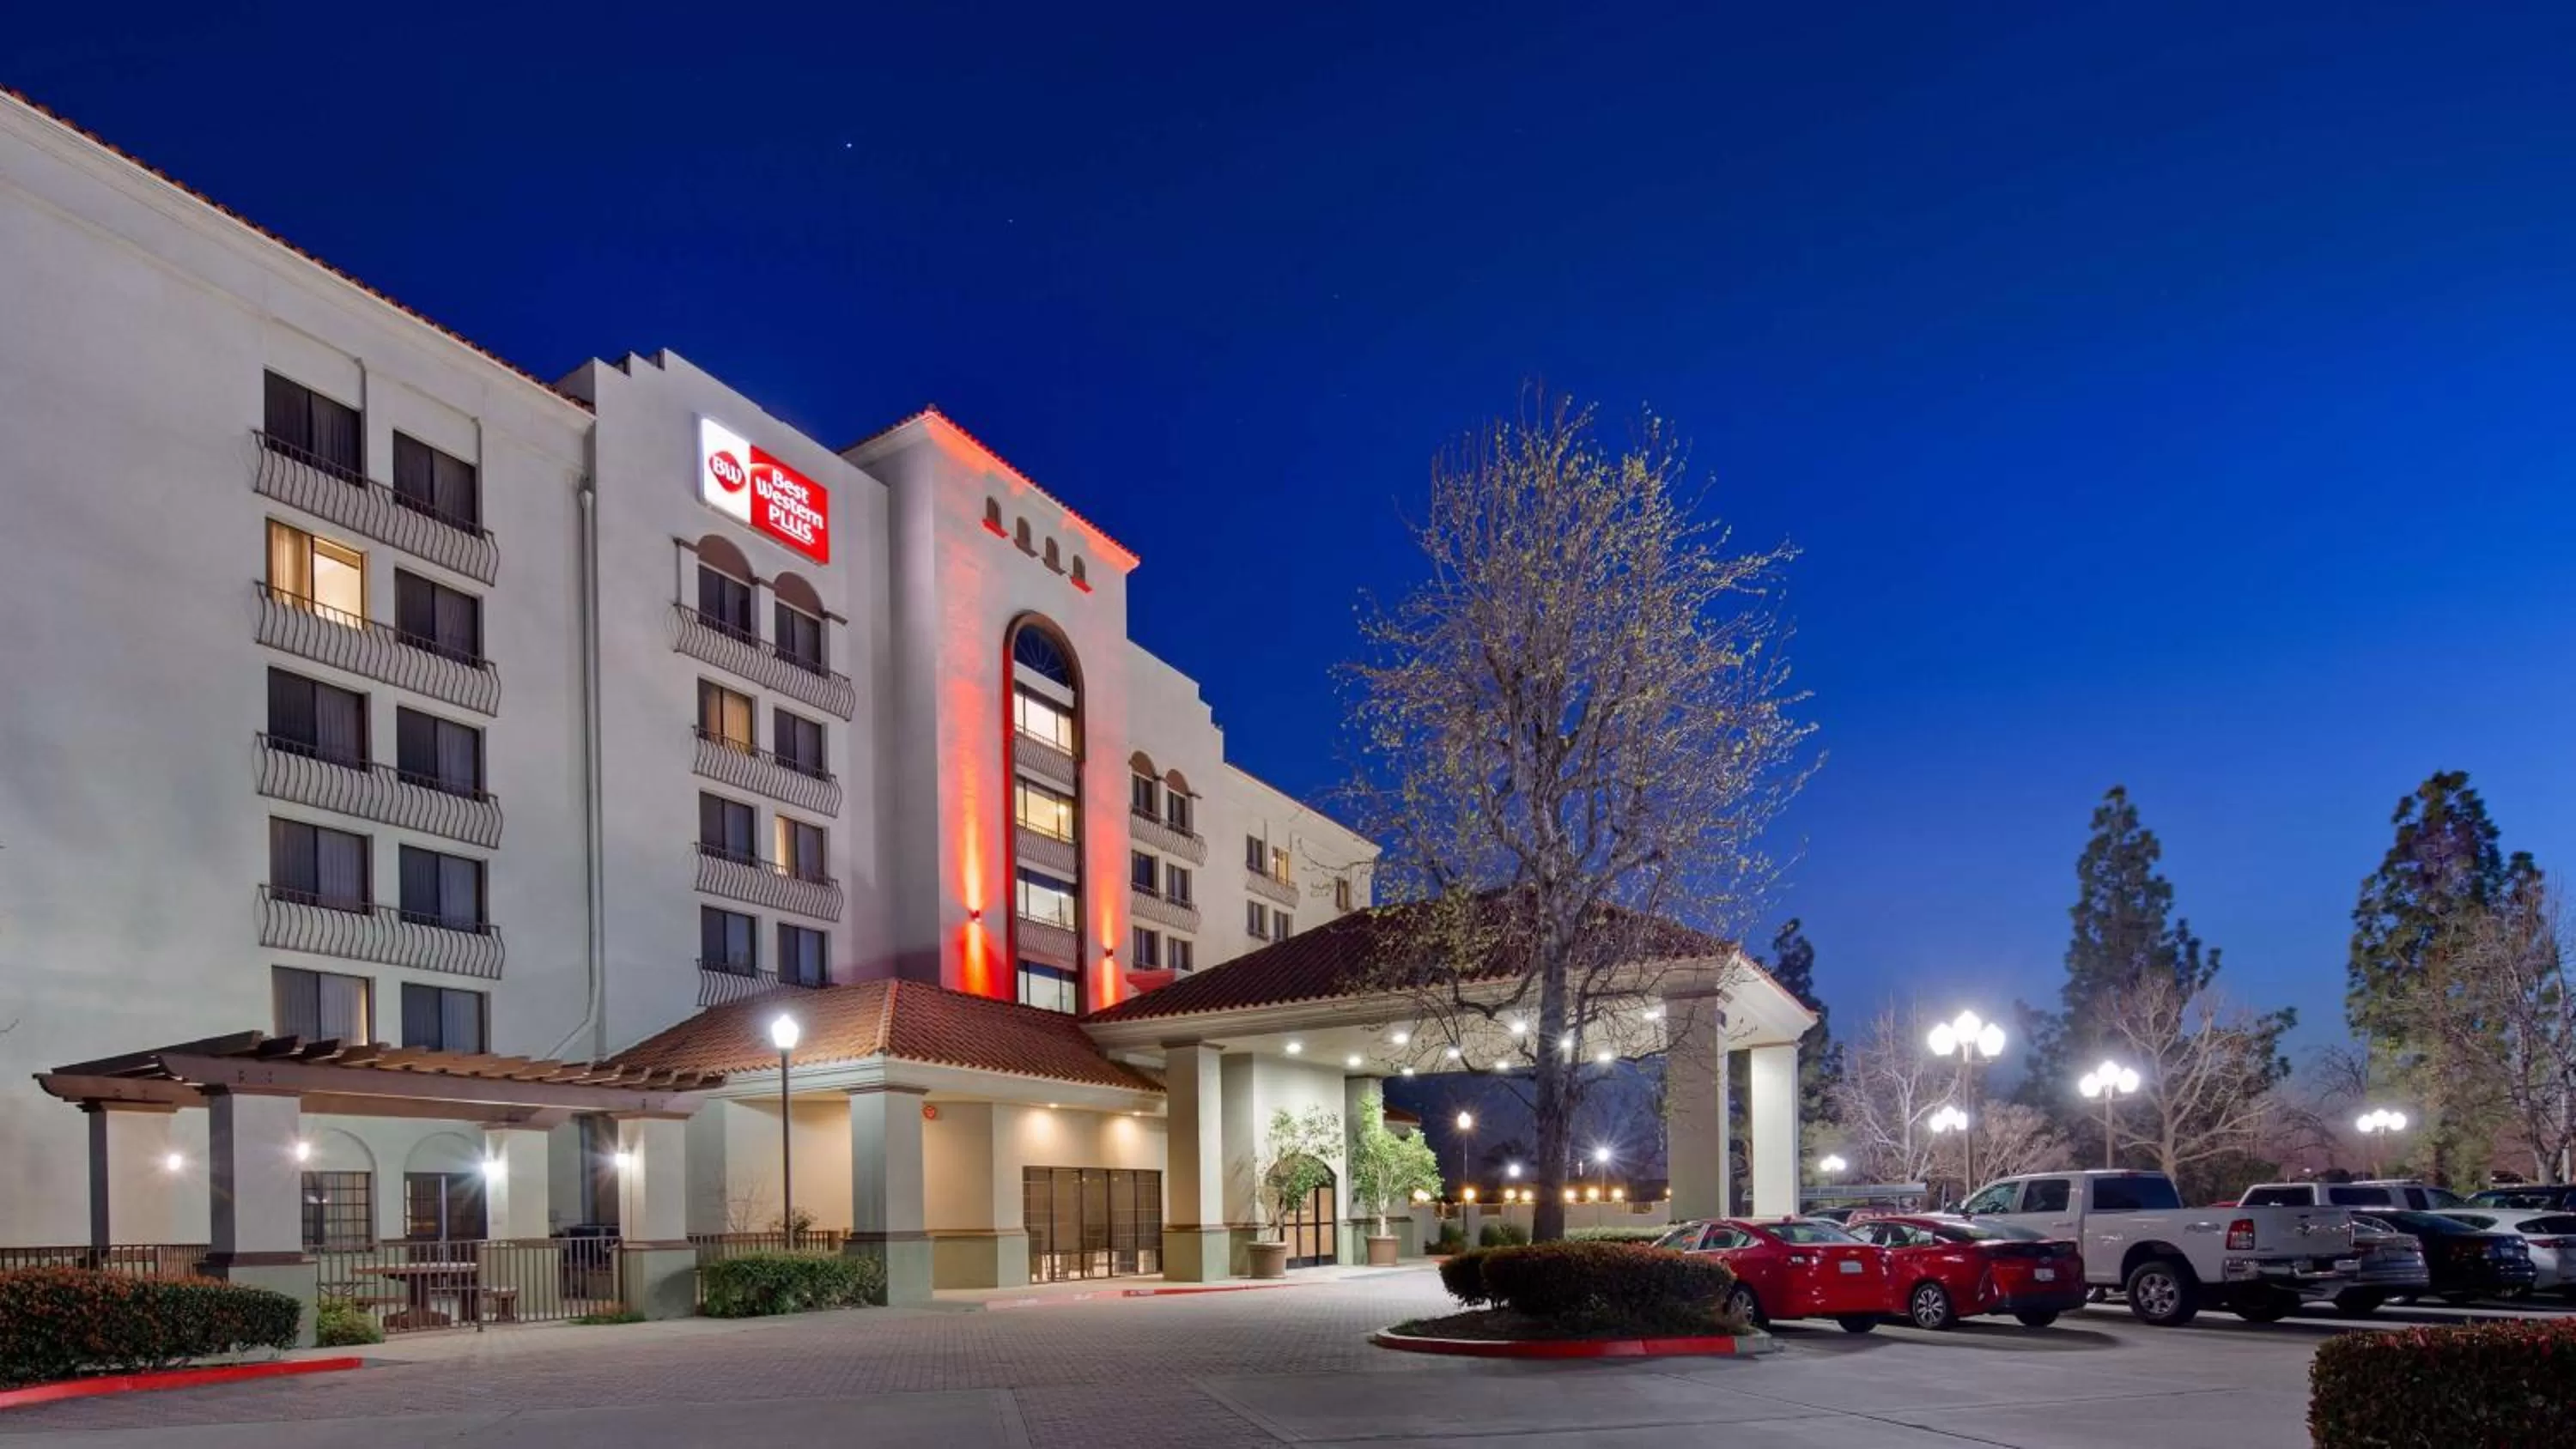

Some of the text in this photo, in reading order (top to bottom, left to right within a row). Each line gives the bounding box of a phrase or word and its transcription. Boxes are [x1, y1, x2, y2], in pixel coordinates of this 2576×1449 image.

[713, 455, 742, 485] BW
[772, 469, 810, 504] Best
[755, 476, 824, 530] Western
